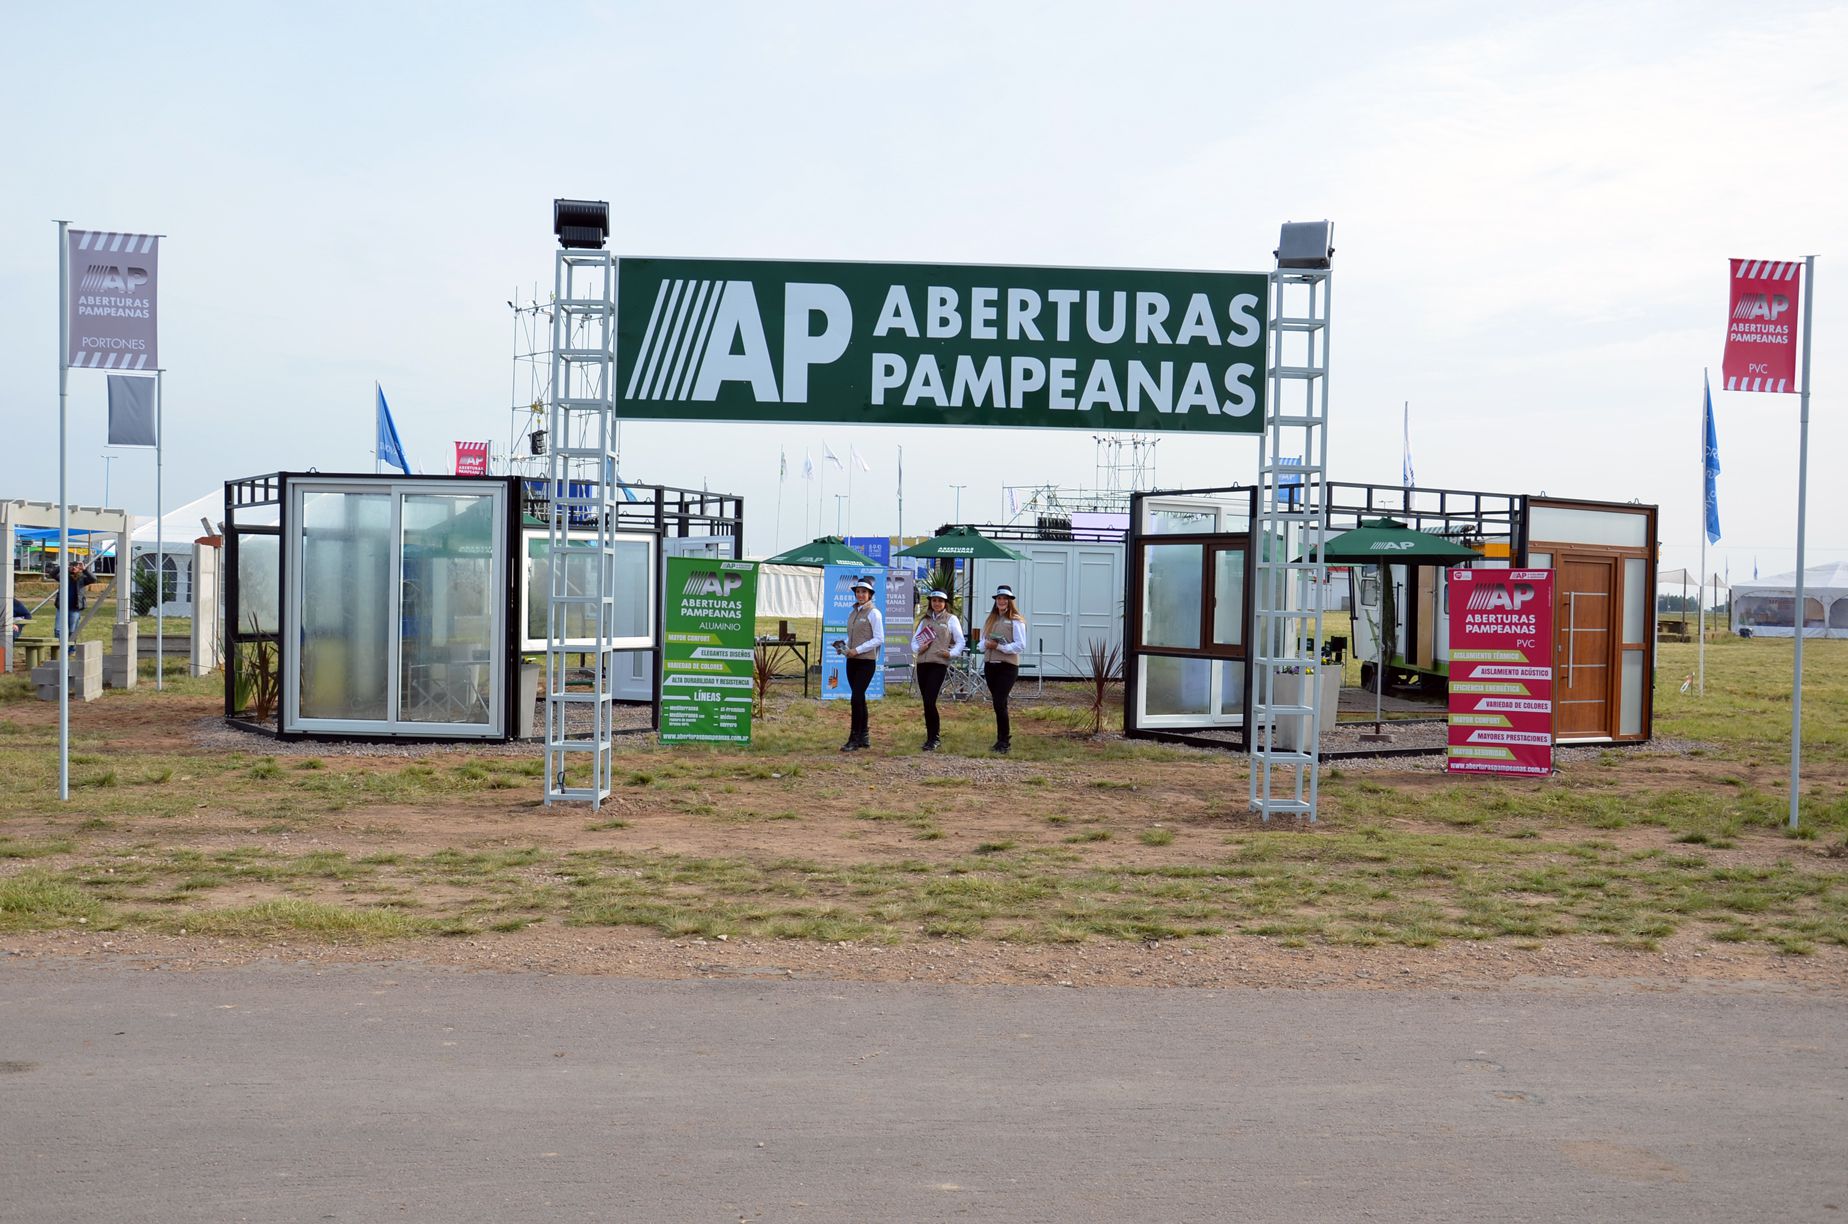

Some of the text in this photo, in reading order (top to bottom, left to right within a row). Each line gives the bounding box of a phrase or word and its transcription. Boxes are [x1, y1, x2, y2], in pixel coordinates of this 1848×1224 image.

[79, 295, 150, 308] ABERTURAS
[79, 306, 150, 318] PAMPEANAS
[873, 284, 1260, 347] ABERTURAS
[1731, 323, 1789, 334] ABERTURAS
[82, 336, 145, 350] PORTONES
[1730, 333, 1788, 344] PAMPEANAS
[1749, 363, 1768, 374] PVC
[871, 353, 1256, 417] PAMPEANAS
[681, 599, 742, 609] ABERTURAS
[681, 608, 742, 619] PAMPEANAS
[1466, 614, 1536, 623] ABERTURAS
[699, 622, 741, 631] ALUMINIO
[1466, 625, 1536, 634] PAMPEANAS
[1516, 639, 1535, 648] PVC
[701, 649, 751, 658] ELEGANTES DISEÑOS
[1481, 668, 1549, 677] AISLAMIENTO ACÚSTICO
[694, 689, 721, 702] LÍNEAS
[1485, 700, 1548, 710] VARIEDAD DE COLORES
[1477, 733, 1548, 743] MAYORES PRESTACIONES
